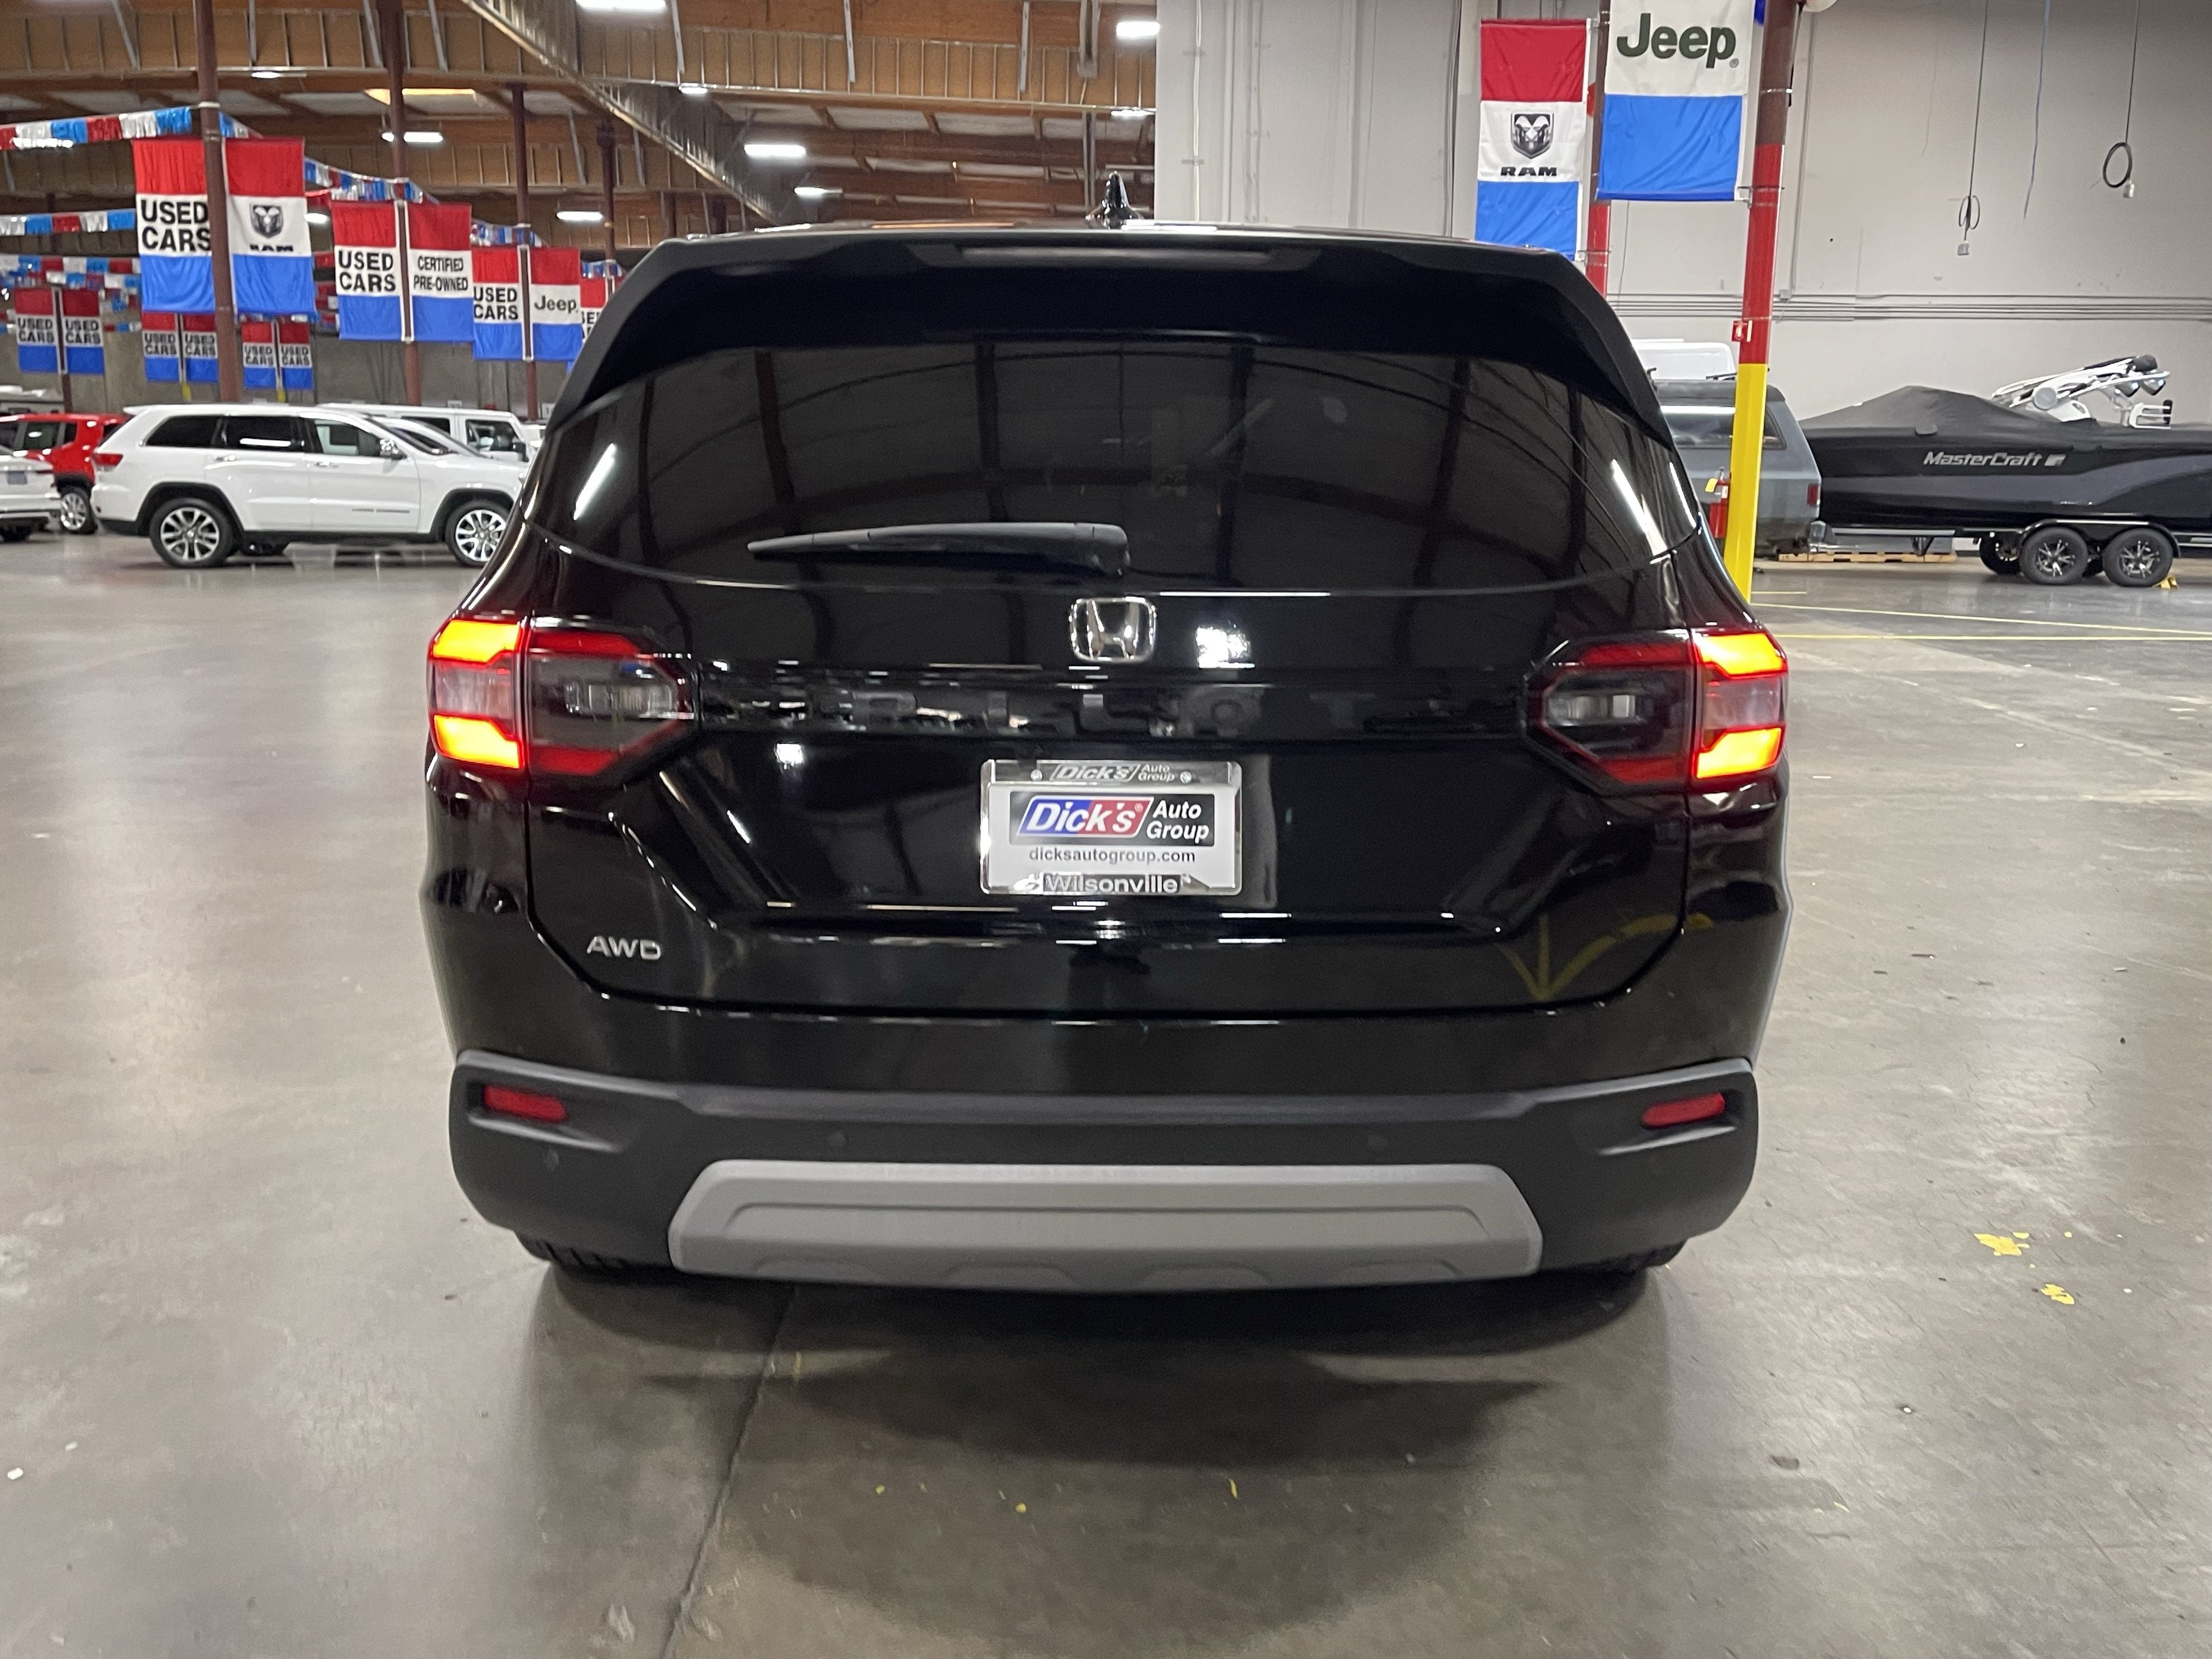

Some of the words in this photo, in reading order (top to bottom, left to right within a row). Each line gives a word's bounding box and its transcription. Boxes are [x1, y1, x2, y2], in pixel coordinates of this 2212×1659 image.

[1617, 13, 1736, 68] Jeep
[1500, 166, 1558, 177] RAM
[141, 200, 208, 224] USED
[142, 226, 211, 251] CARS
[338, 251, 394, 271] USED
[417, 256, 464, 272] CERTIFIED
[340, 272, 396, 292] CARS
[414, 276, 468, 291] PRE-OWNED
[473, 286, 517, 302] USED
[473, 304, 518, 320] CARS
[534, 296, 577, 313] Jeep
[18, 318, 53, 329] USED
[65, 319, 99, 331] USED
[65, 331, 100, 343] CARS
[1923, 452, 2042, 466] MasterCraft
[1141, 764, 1170, 772] Auto
[1138, 772, 1175, 782] Group
[1026, 802, 1136, 833] Dick's
[1153, 800, 1202, 819] Auto
[1146, 822, 1210, 843] Group
[1029, 847, 1196, 865] dicksautogroup.com
[1045, 874, 1178, 893] Wilsonville
[586, 935, 661, 960] AWD
